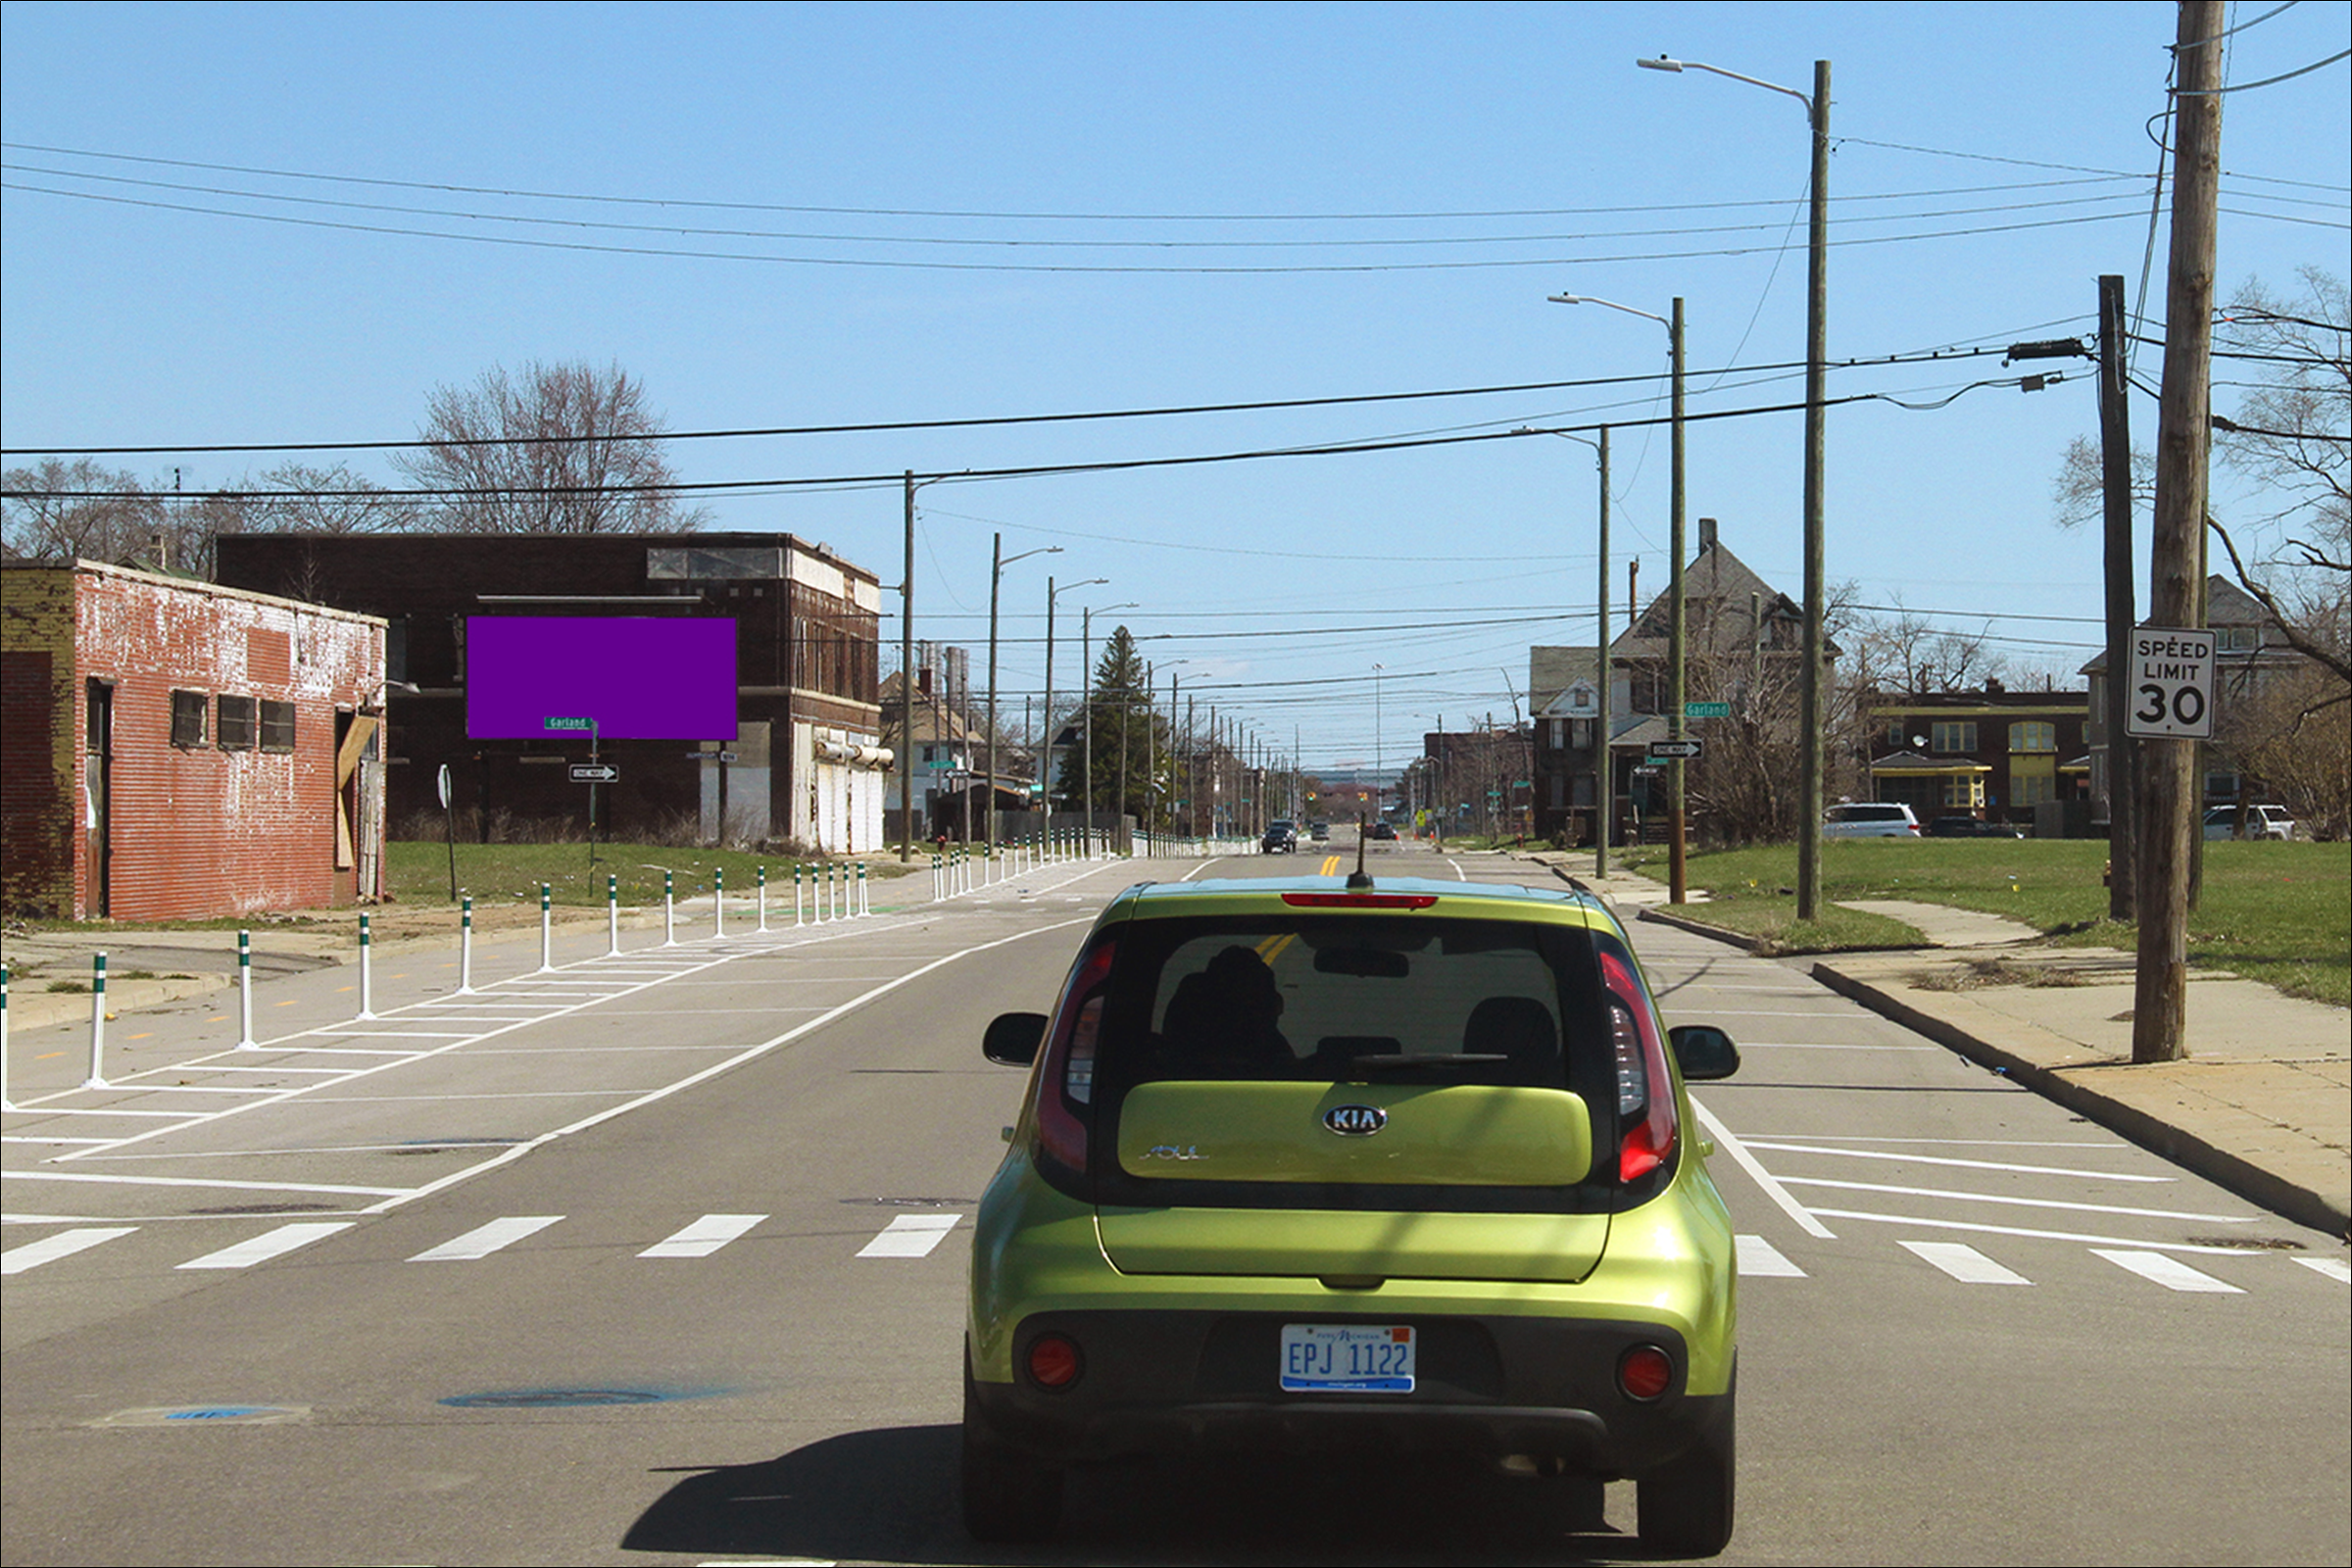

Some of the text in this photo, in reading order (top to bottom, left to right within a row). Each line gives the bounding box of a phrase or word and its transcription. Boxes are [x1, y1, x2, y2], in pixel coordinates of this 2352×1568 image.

[2137, 640, 2208, 659] SPEED
[2144, 662, 2199, 680] LIMIT
[1687, 704, 1728, 715] Garland
[2135, 684, 2205, 725] 30
[550, 716, 586, 727] Garland
[1334, 1109, 1377, 1128] KIA
[1289, 1343, 1407, 1376] EPJ 1122
